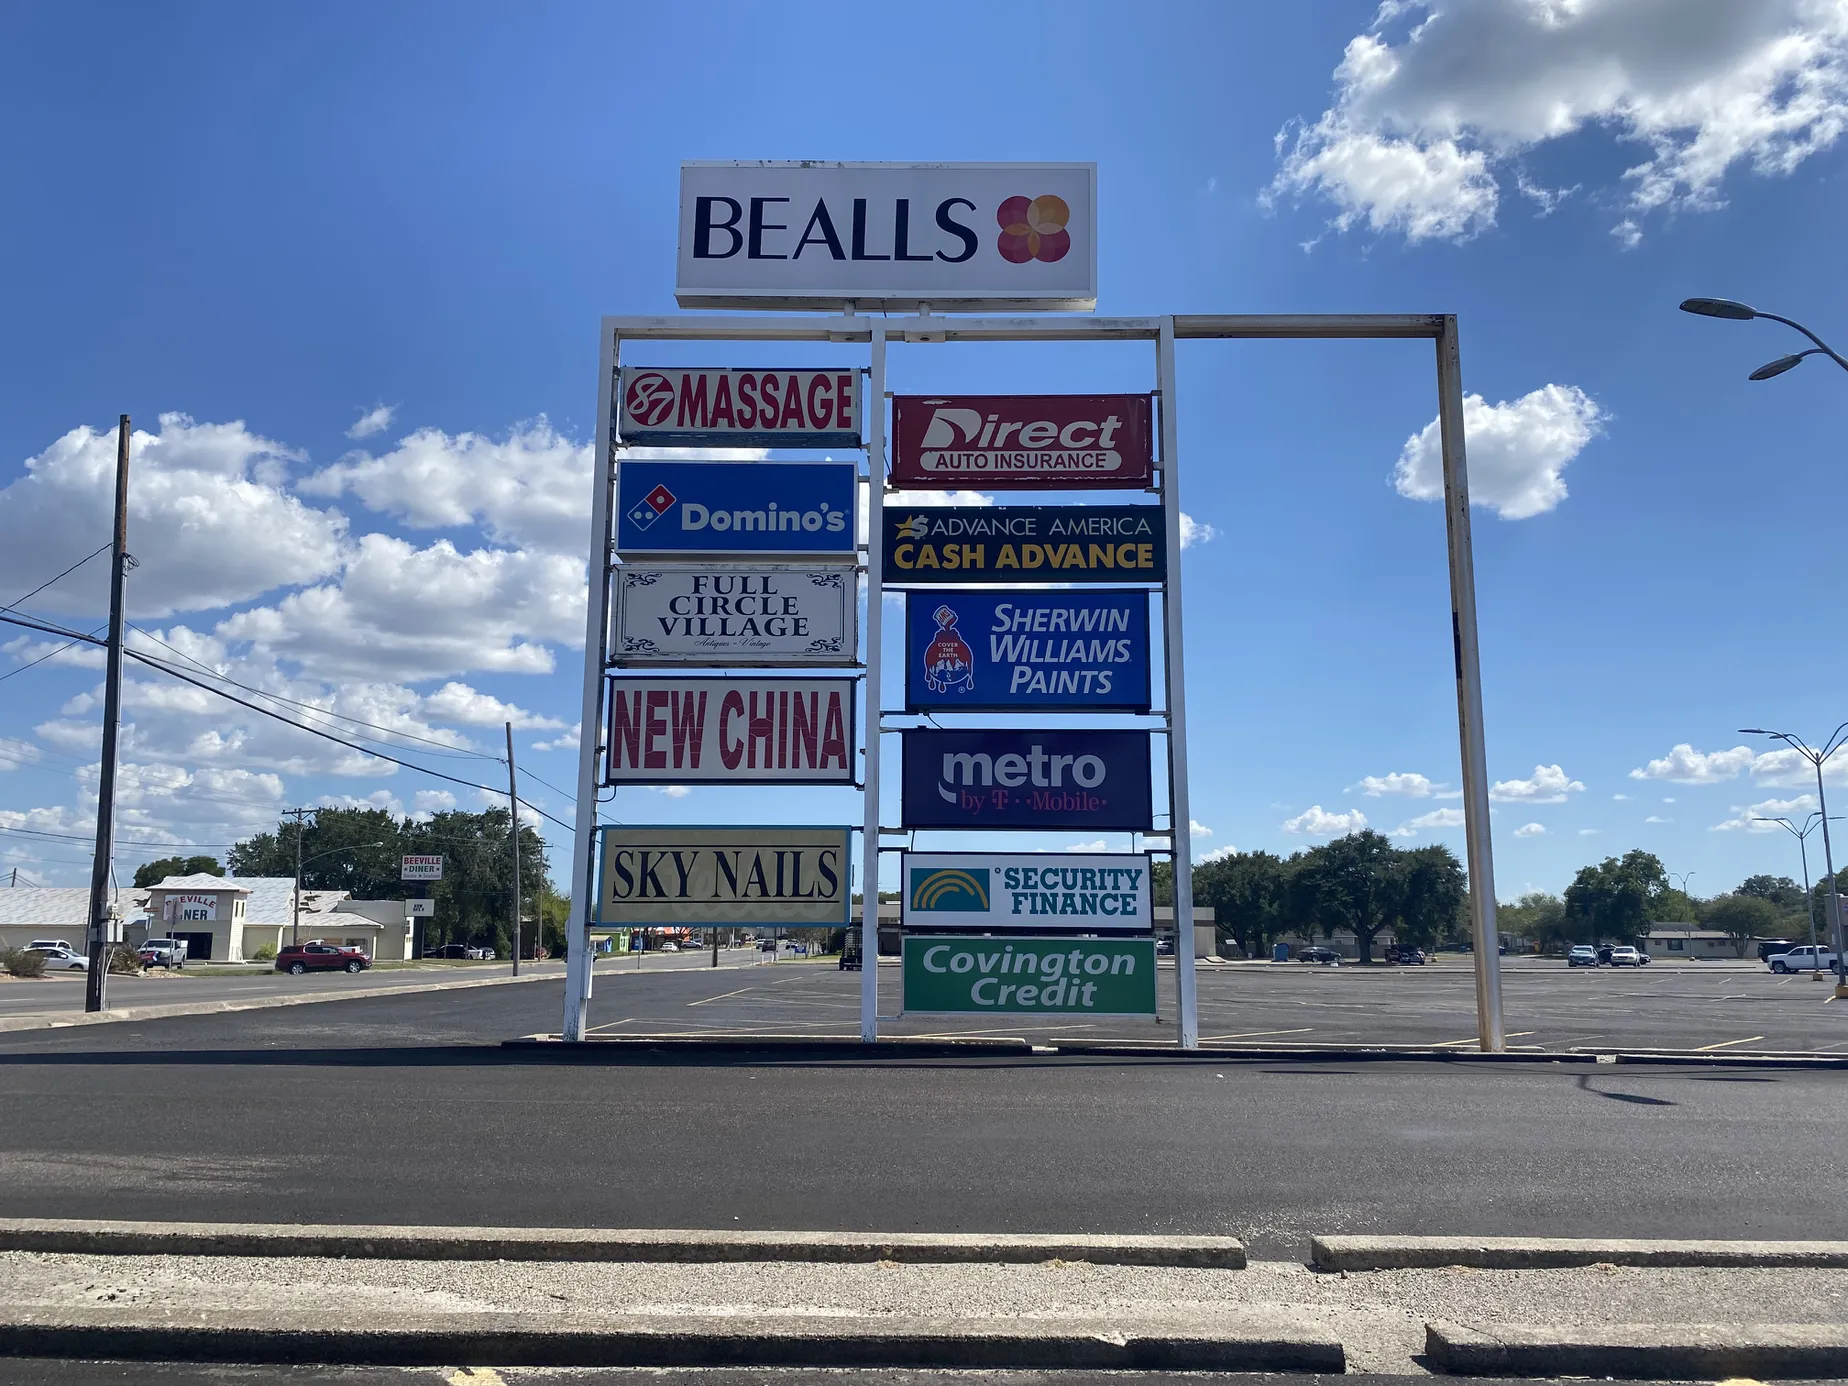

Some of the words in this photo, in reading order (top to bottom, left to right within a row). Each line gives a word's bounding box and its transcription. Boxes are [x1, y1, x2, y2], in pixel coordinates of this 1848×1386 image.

[692, 196, 979, 264] BEALLS
[676, 373, 853, 430] MASSAGE
[920, 408, 1123, 449] Direct
[935, 453, 988, 469] AUTO
[994, 452, 1107, 469] INSURANCE
[681, 502, 846, 532] Domino's
[931, 518, 1036, 536] ADVANCE
[1049, 517, 1153, 536] AMERICA
[894, 543, 985, 570] CASH
[995, 543, 1154, 570] ADVANCE
[691, 575, 778, 595] FULL
[669, 596, 799, 616] CIRCLE
[991, 603, 1130, 633] SHERWIN
[658, 617, 809, 637] VILLAGE
[693, 637, 730, 650] Antiques
[739, 637, 772, 649] Vintage
[990, 635, 1131, 663] WILLIAMS
[1009, 666, 1113, 695] PAINTS
[612, 690, 708, 769] NEW
[719, 689, 848, 770] CHINA
[938, 744, 1107, 797] metro
[961, 790, 985, 815] by
[612, 850, 700, 899] SKY
[711, 850, 838, 899] NAILS
[1004, 867, 1143, 891] SECURITY
[1011, 893, 1137, 916] FINANCE
[923, 945, 1136, 982] Covington
[970, 977, 1098, 1007] Credit
